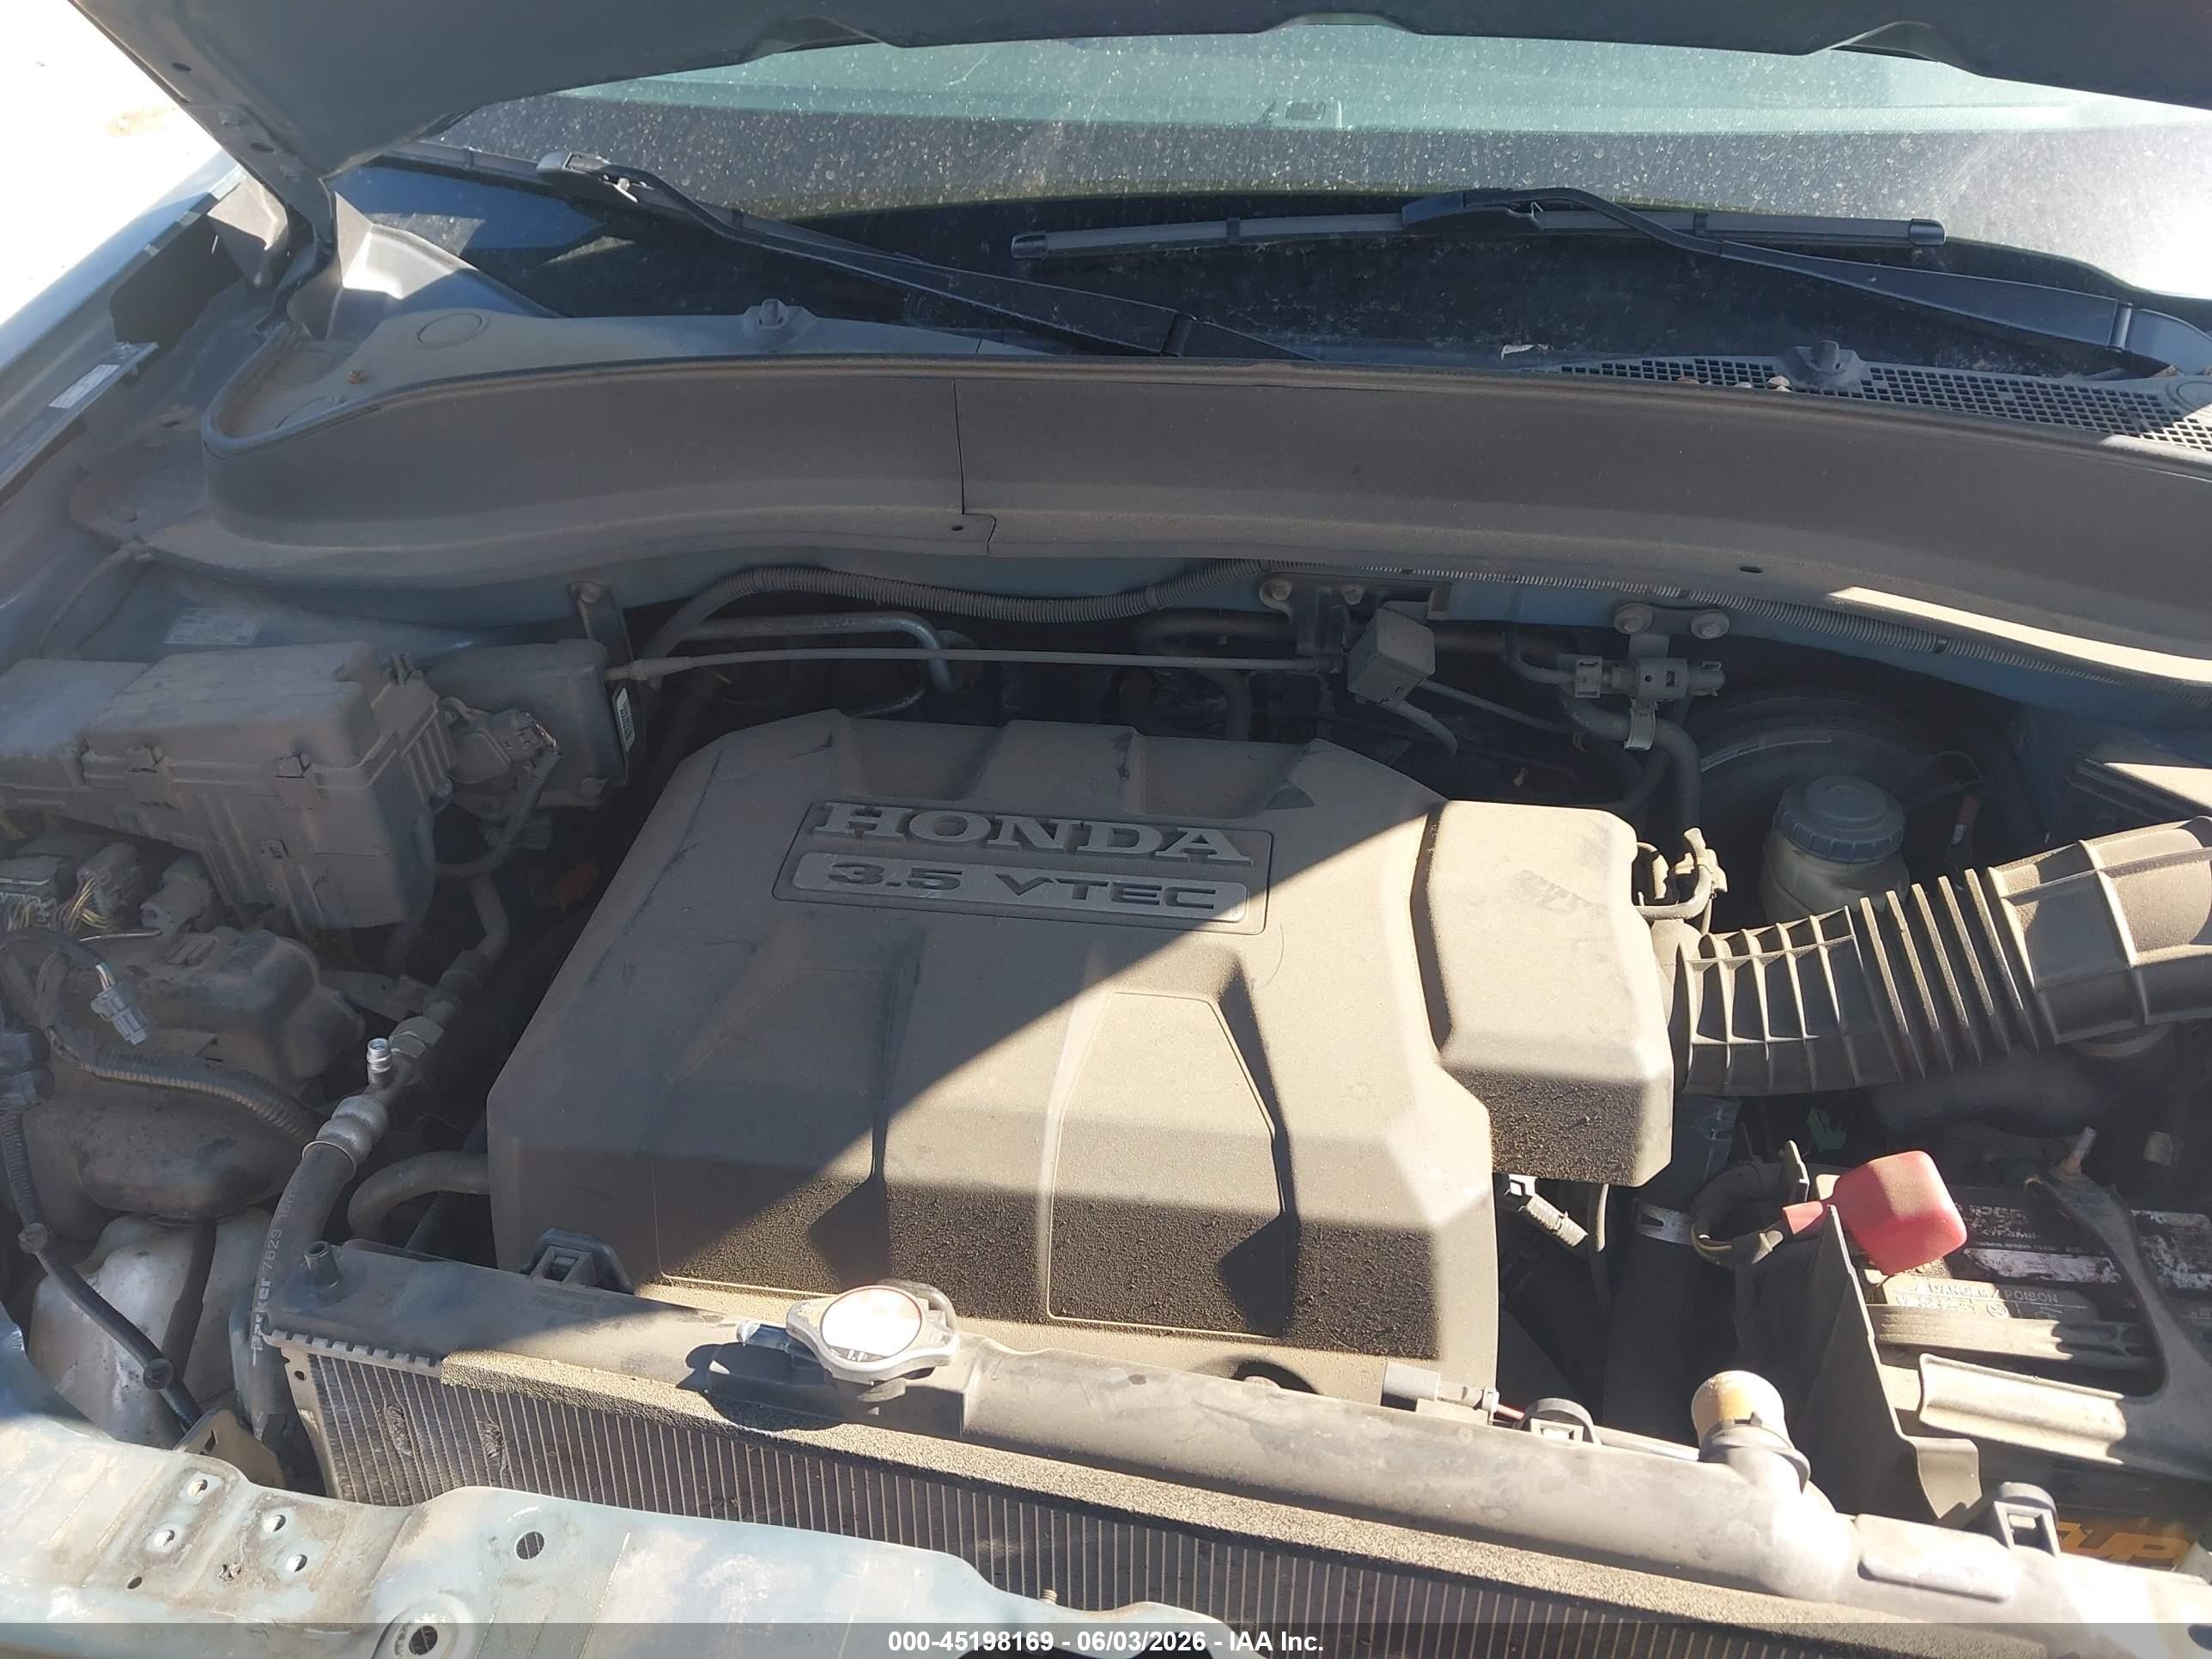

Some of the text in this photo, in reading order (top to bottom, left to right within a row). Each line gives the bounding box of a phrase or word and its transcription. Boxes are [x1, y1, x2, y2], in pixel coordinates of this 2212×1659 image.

[811, 803, 1253, 866] HONDA
[826, 861, 1217, 910] 3.5 VTEC
[251, 1278, 273, 1366] Parker
[263, 1228, 283, 1271] 7629
[2003, 1289, 2060, 1304] POISON
